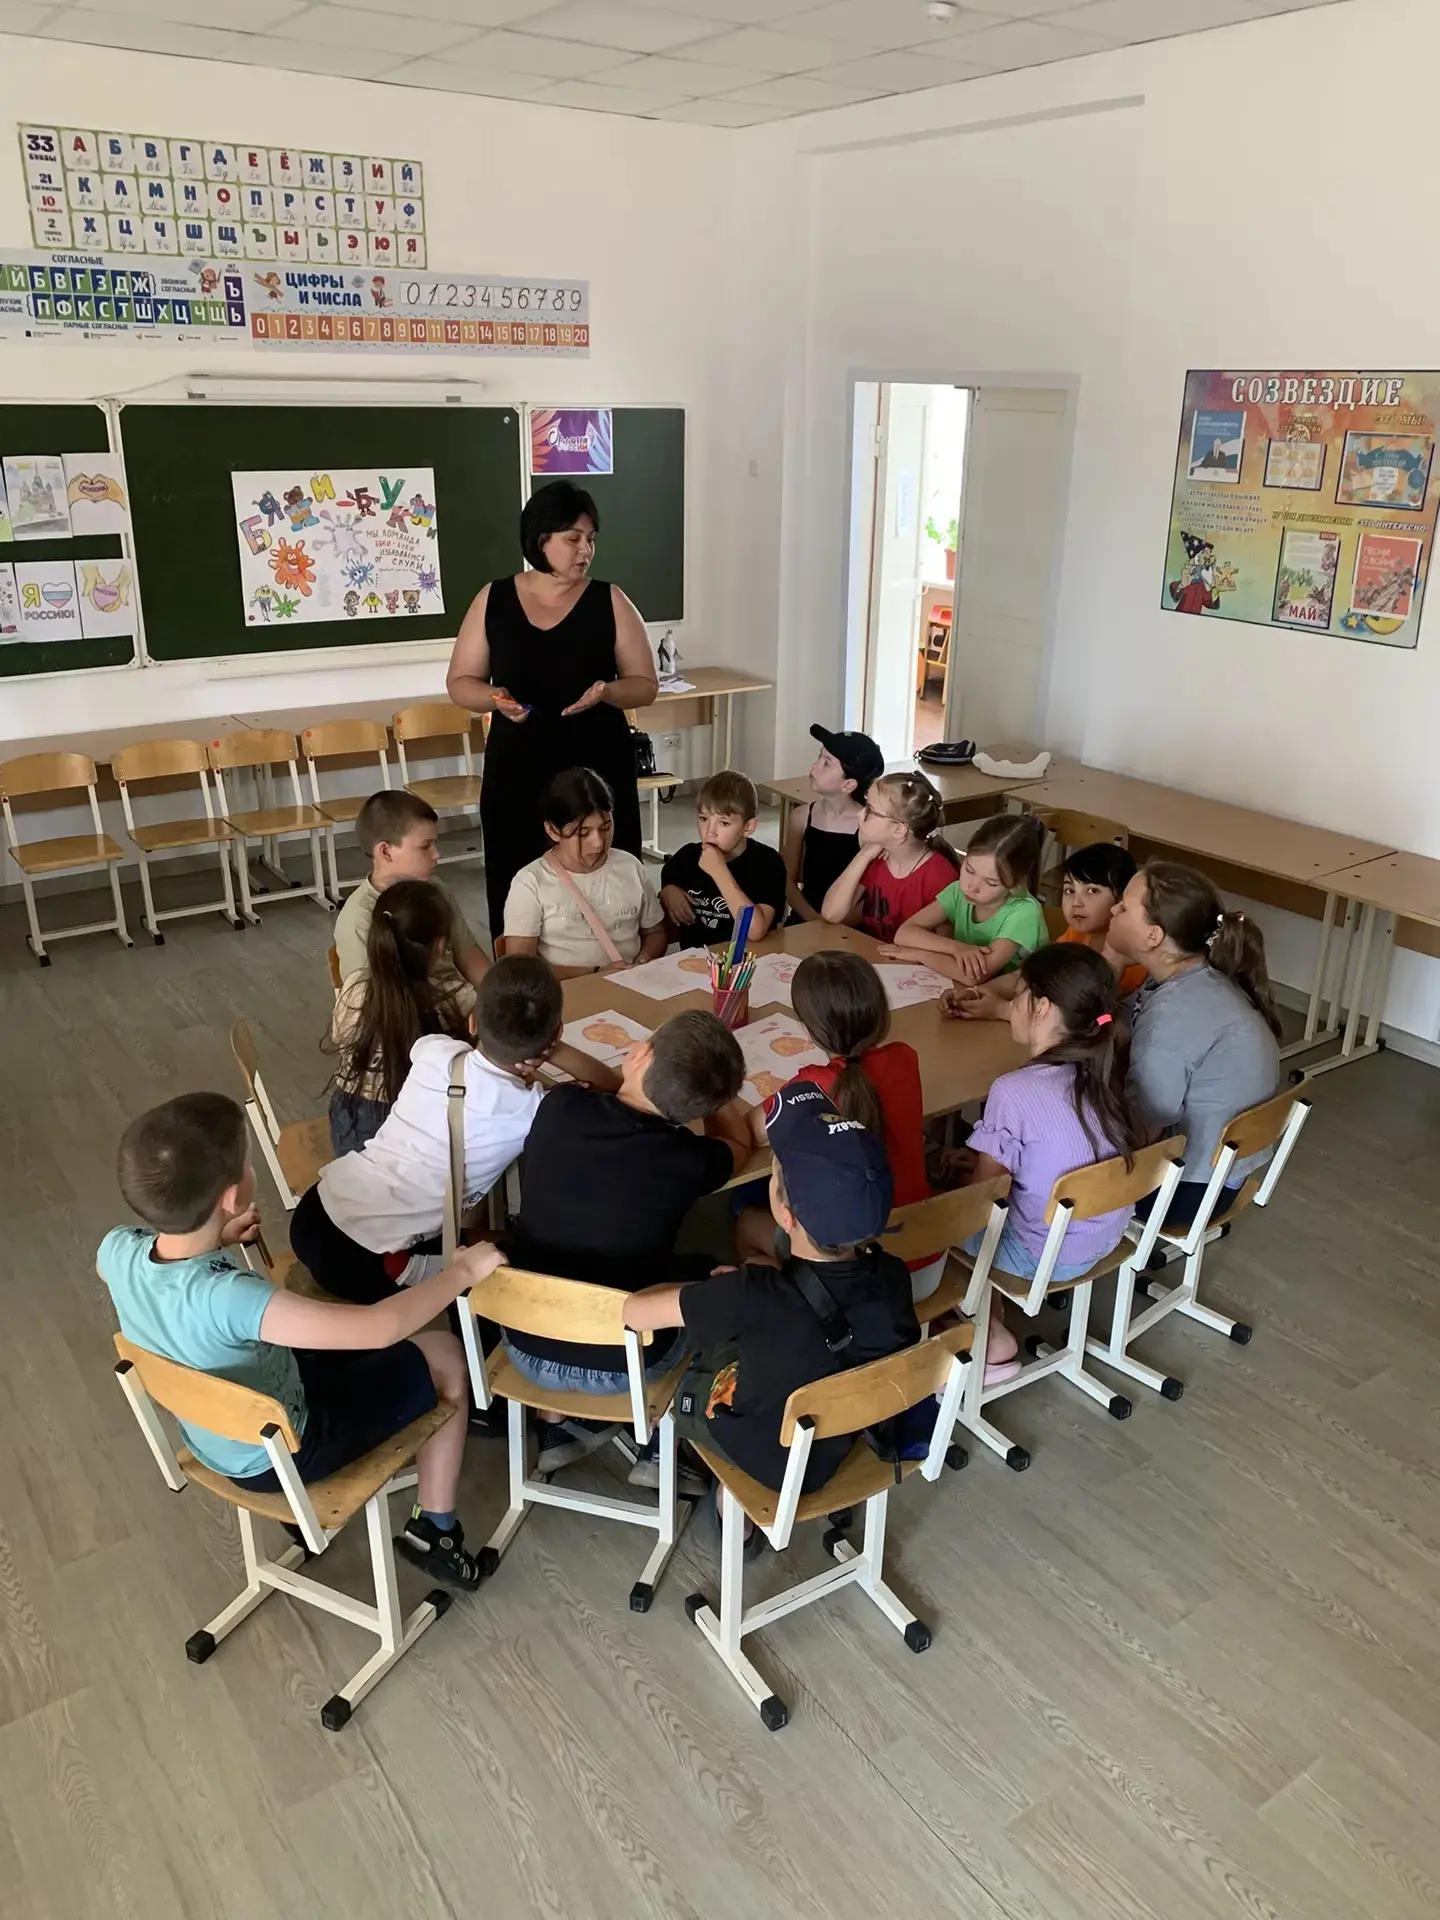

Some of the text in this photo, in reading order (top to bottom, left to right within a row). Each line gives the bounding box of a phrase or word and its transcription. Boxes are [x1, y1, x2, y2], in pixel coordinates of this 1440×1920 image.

[26, 134, 54, 152] 33
[73, 136, 412, 181] А Б В Г Д Е Ё Ж З И Й
[39, 173, 52, 184] 21
[42, 196, 55, 206] 10
[78, 177, 414, 216] К Л М Н О П Р С Т У Ф
[48, 219, 55, 228] 2
[83, 217, 416, 252] Х Ц Ч Ш Щ Ъ Ы Ь Э Ю Я
[52, 254, 103, 265] СОГЛАСНЫЕ
[11, 267, 150, 295] Й Б В Г З Д Ж
[286, 272, 344, 288] ЦИФРЫ
[226, 282, 239, 297] Ъ
[299, 291, 362, 307] И ЧИСЛА
[37, 299, 241, 325] П Ф К С Т Ш Х Ц Ч Щ Ь
[256, 318, 587, 342] 0 1 2 3 4 5 6 7 8 9 10 11 12 13 14 15 16 17 18 19 20
[1232, 377, 1404, 410] СОЗВЕЗДИЕ
[1376, 413, 1399, 425] ЭТО
[366, 529, 420, 544] МЫ КОМАНДА
[1363, 546, 1390, 555] ПЕСНИ
[392, 558, 423, 570] СКУКИ
[22, 583, 41, 608] Я
[25, 610, 74, 620] РОССИЮ!
[1288, 604, 1317, 621] МАЙ
[787, 1092, 824, 1105] RUSSIA
